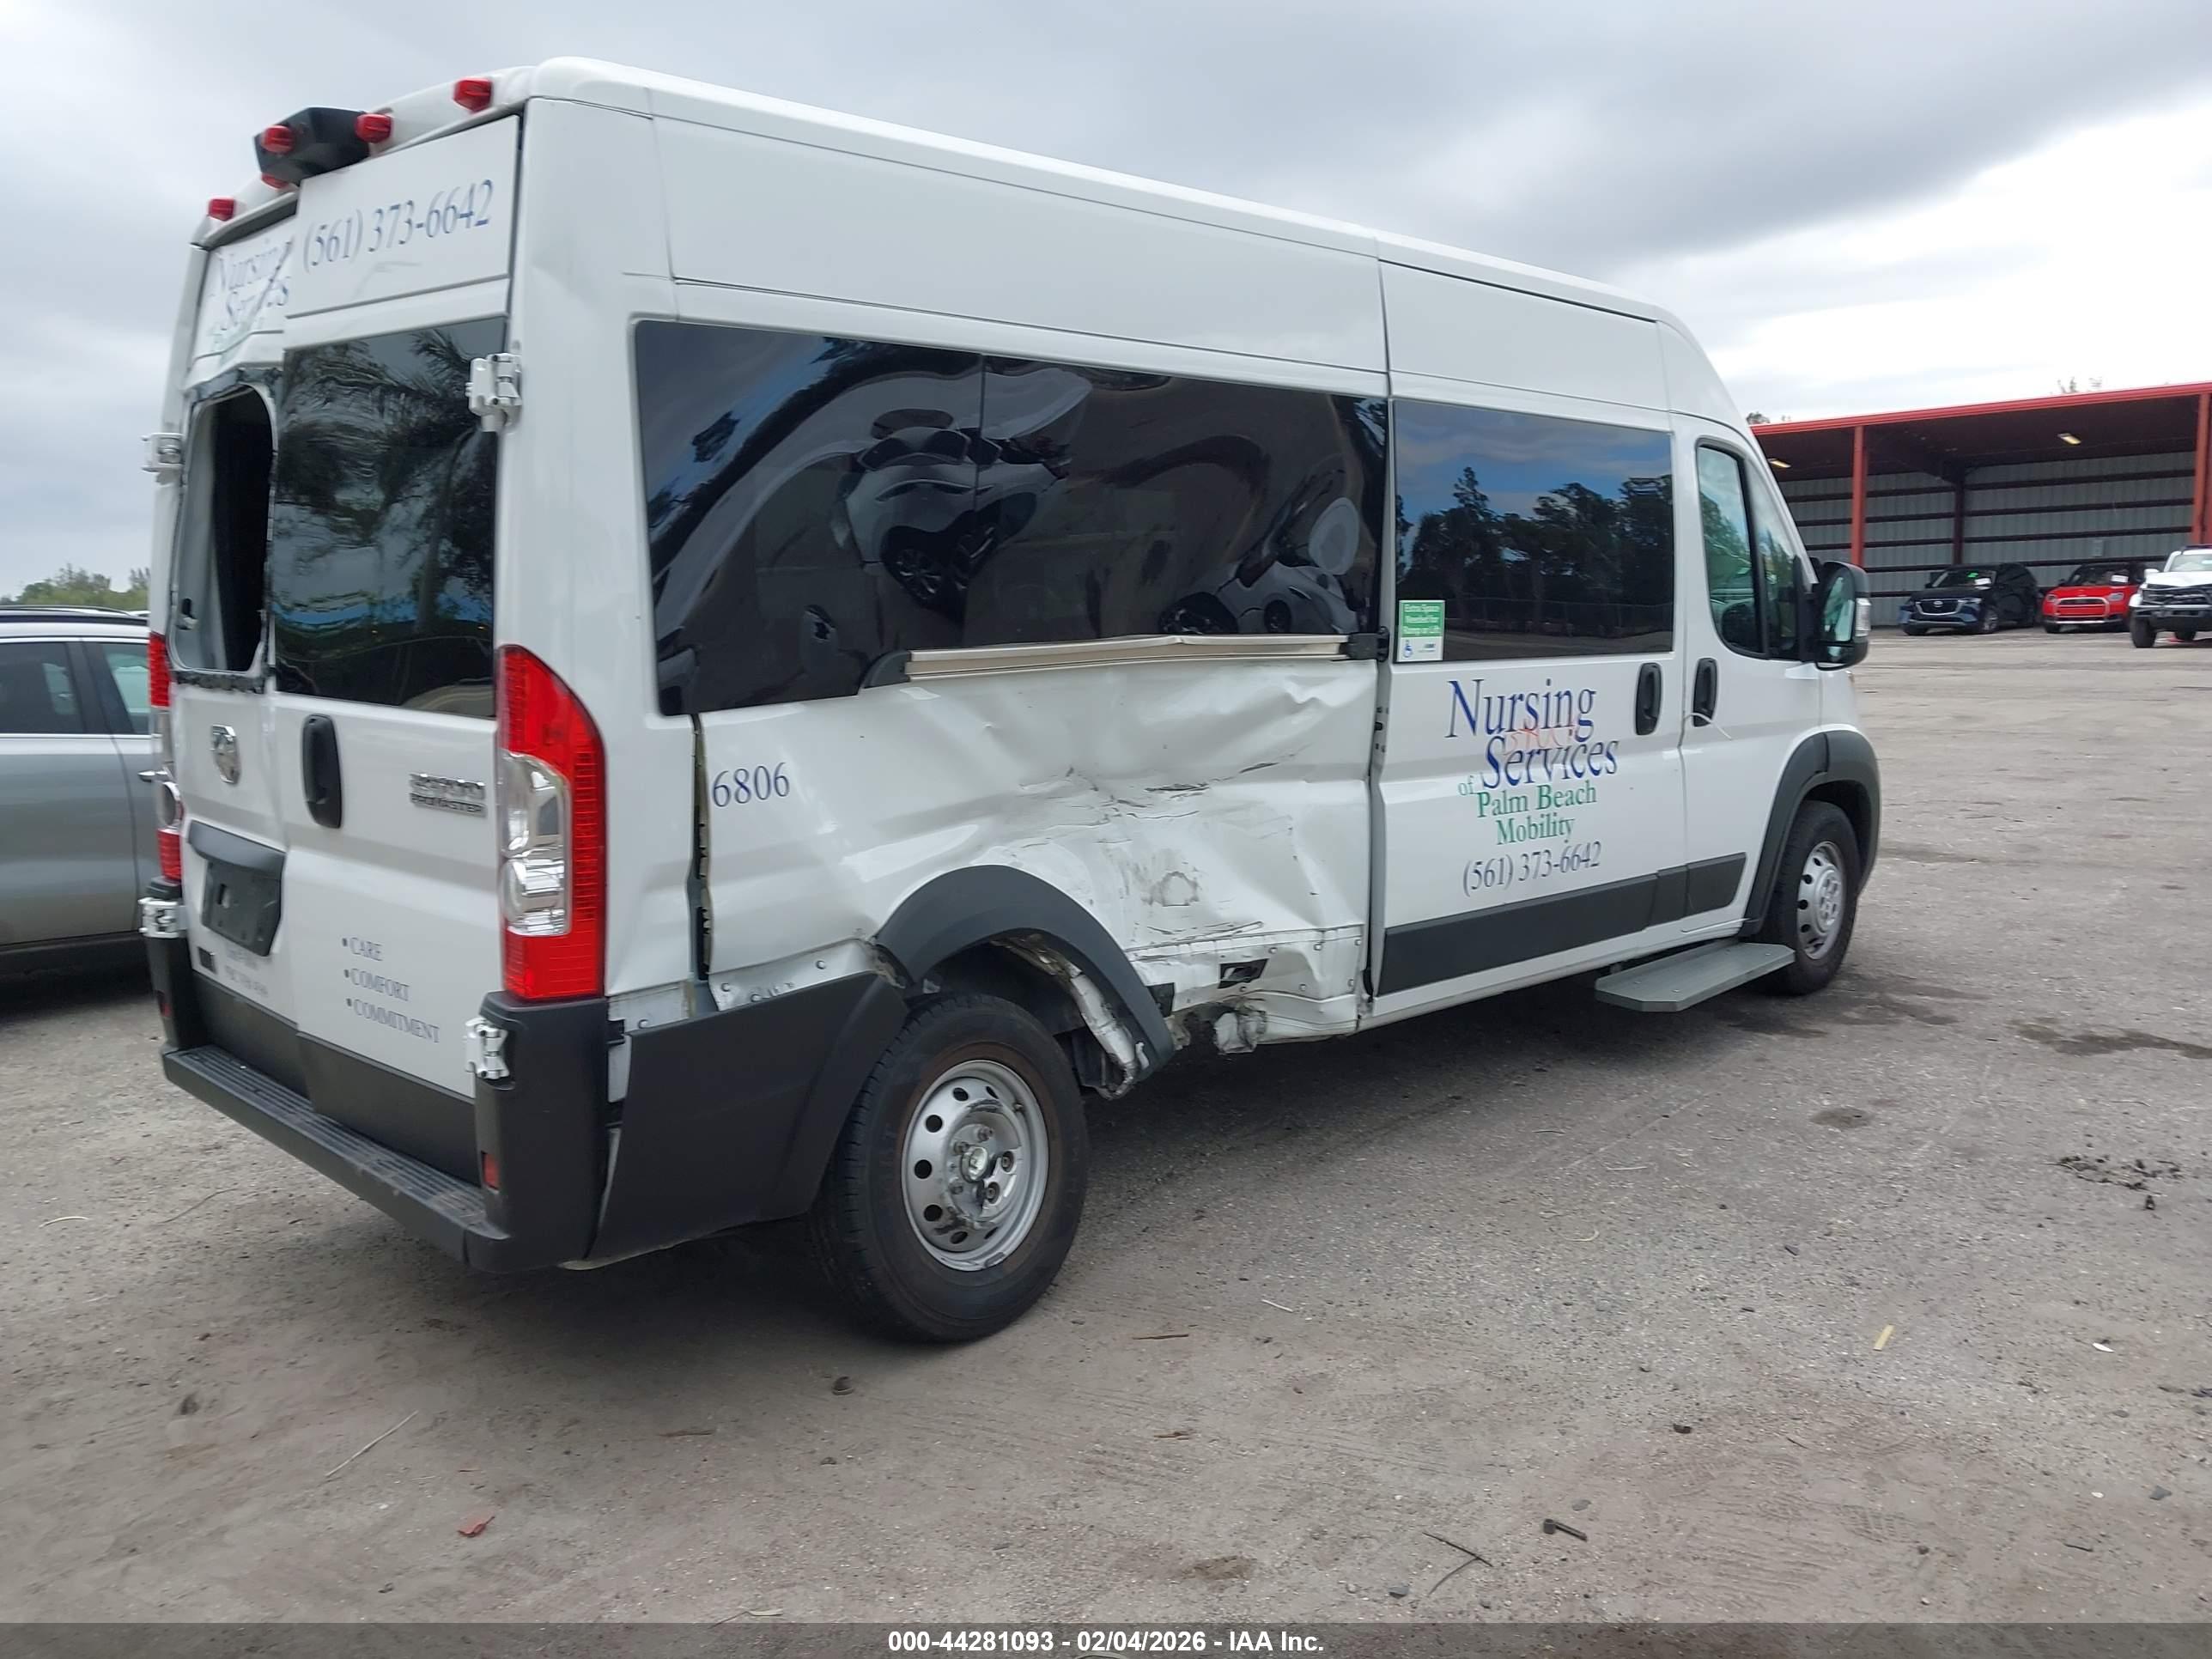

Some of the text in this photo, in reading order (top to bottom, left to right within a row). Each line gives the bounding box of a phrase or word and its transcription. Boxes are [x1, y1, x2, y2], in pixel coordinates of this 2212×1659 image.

[303, 179, 493, 274] (561) 373-6642
[1445, 678, 1596, 741] Nursing
[712, 761, 790, 808] 6806
[1457, 775, 1476, 797] of
[1483, 738, 1620, 790] Services
[1476, 780, 1597, 818] Palm Beach
[1496, 812, 1575, 846] Mobility
[1462, 841, 1602, 897] (561) 373-6642
[349, 936, 384, 962] CARE
[349, 968, 410, 1002] COMFORT
[353, 998, 441, 1044] COMMITMENT
